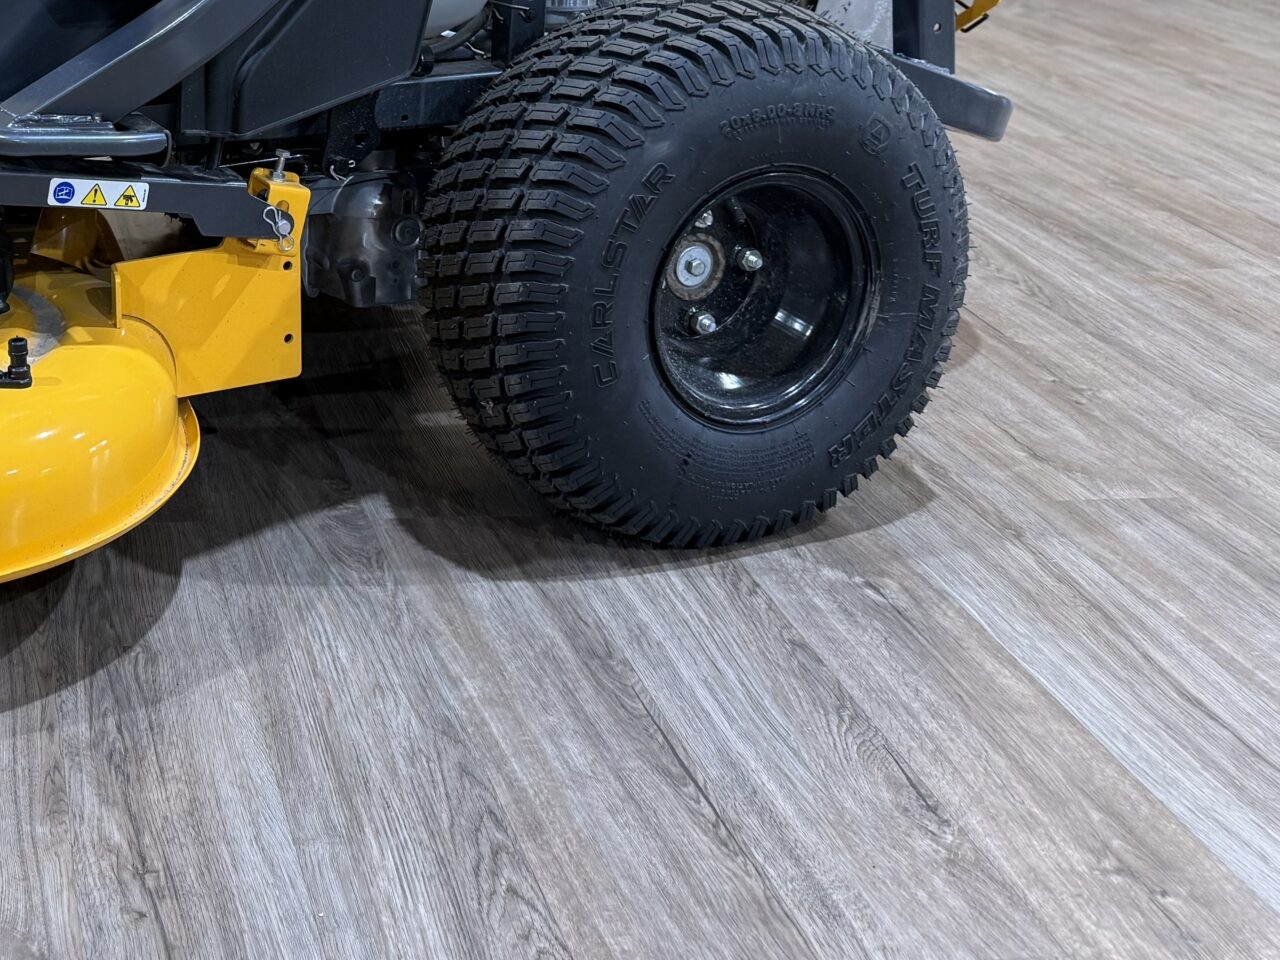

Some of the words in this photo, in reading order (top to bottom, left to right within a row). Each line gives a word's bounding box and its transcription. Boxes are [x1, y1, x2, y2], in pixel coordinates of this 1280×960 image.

[590, 162, 676, 388] CARLSTAR
[901, 161, 942, 278] TURF
[827, 283, 942, 469] MASTER
